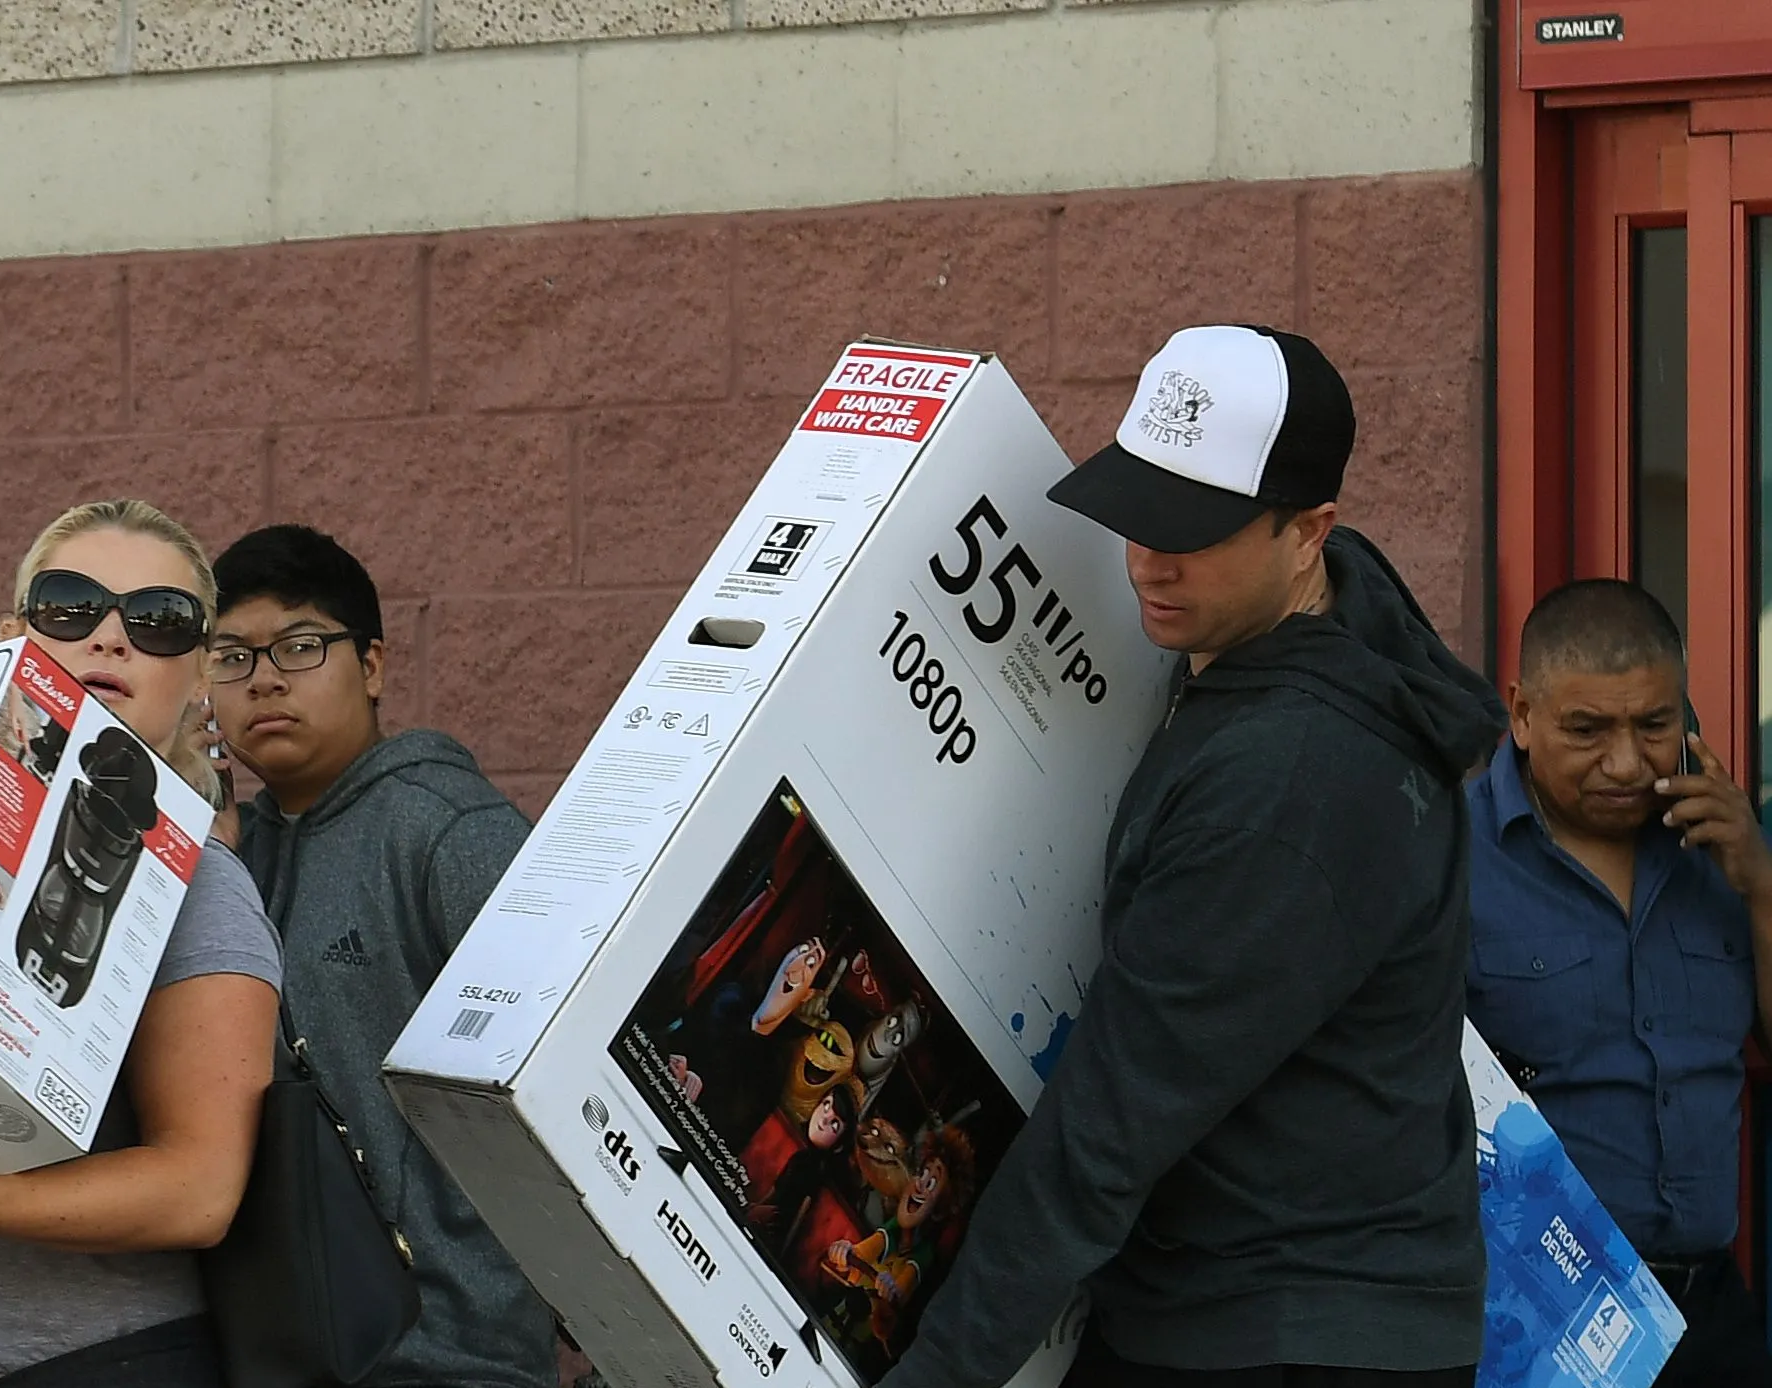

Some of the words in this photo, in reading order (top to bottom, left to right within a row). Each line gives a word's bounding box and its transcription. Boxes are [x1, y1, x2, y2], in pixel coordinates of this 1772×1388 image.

[1542, 19, 1615, 40] STANLEY
[835, 363, 958, 392] FRAGILE
[836, 395, 918, 416] HANDLE
[813, 411, 865, 430] WITH
[865, 415, 921, 436] CARE
[1137, 414, 1194, 448] ARTISTS
[768, 524, 794, 547] 4
[756, 551, 786, 565] MAX
[1020, 631, 1040, 660] CLASS
[878, 610, 976, 765] 1080p
[458, 985, 521, 1004] 55L421U
[40, 1086, 81, 1125] DECKER
[603, 1130, 642, 1182] dts
[657, 1200, 717, 1281] HDMI
[1550, 1215, 1586, 1263] FRONT
[1540, 1230, 1582, 1286] DEVANT
[741, 1301, 770, 1340] SPEAKER
[1599, 1304, 1617, 1328] 4
[726, 1321, 771, 1380] ONKYO
[1587, 1327, 1605, 1353] MAX
